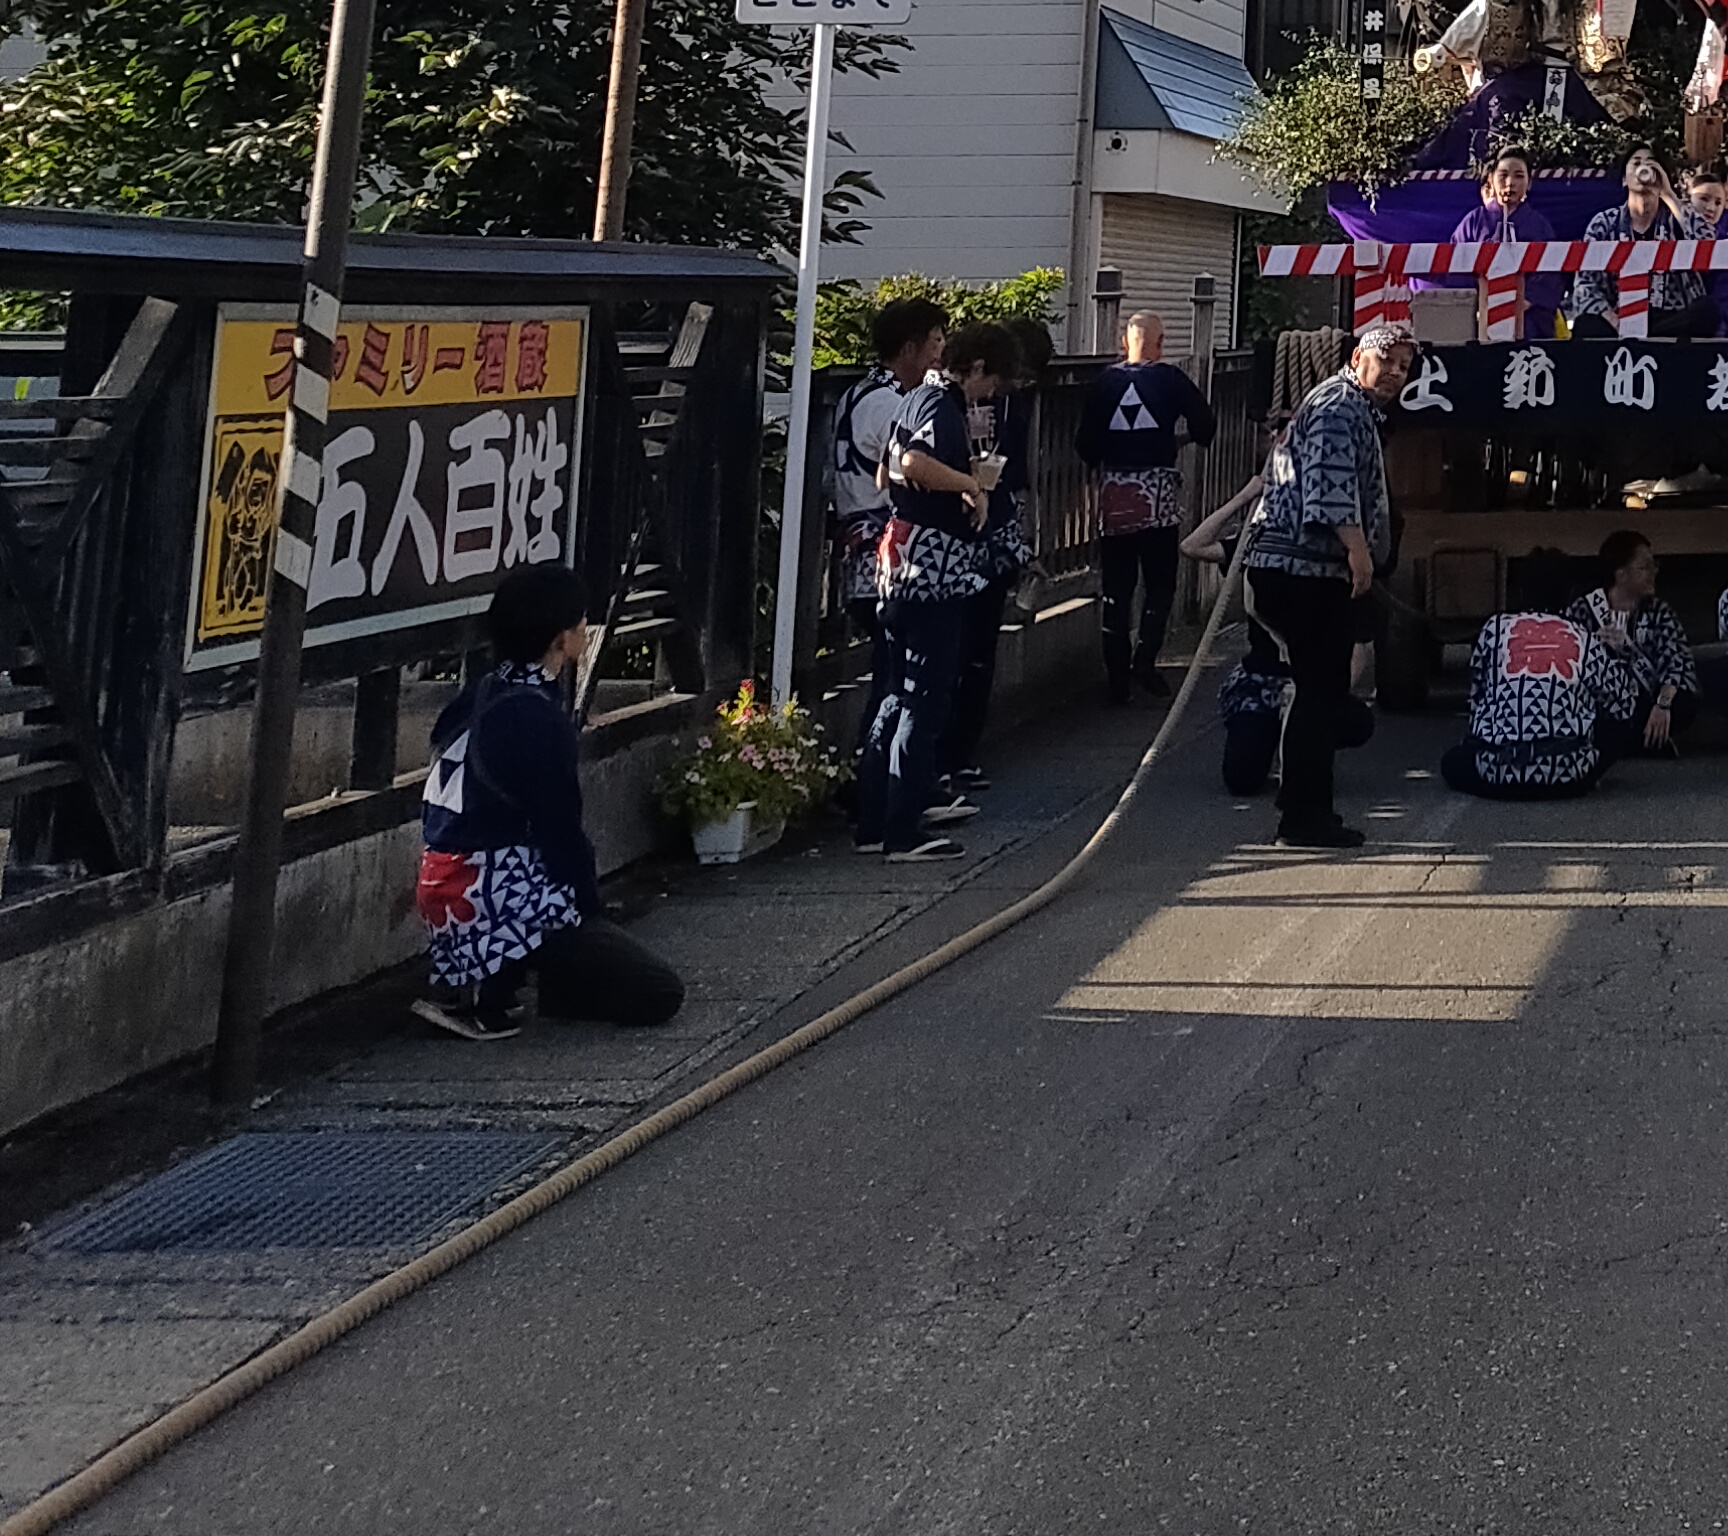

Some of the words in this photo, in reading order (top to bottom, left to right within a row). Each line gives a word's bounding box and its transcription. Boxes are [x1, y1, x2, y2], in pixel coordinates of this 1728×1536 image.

[305, 406, 568, 613] 五人百姓
[1506, 618, 1580, 680] 祭
